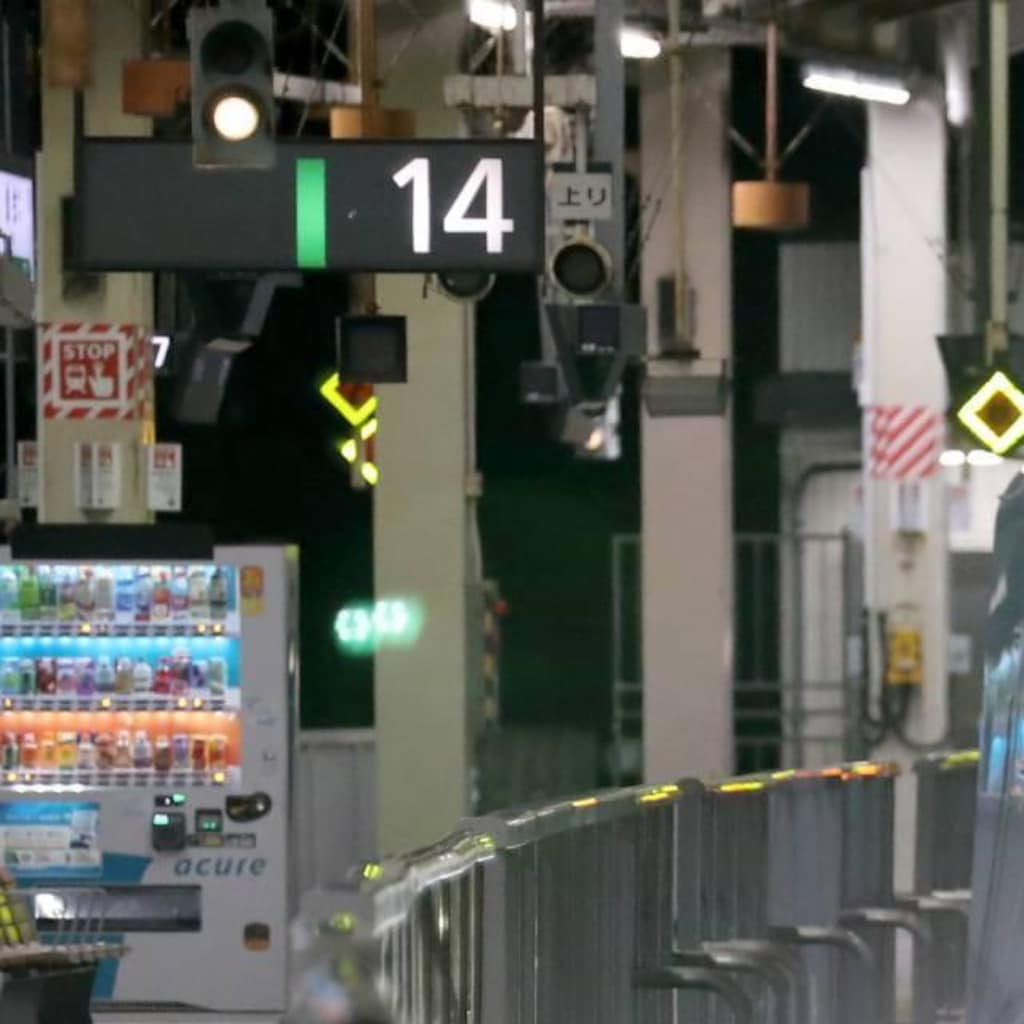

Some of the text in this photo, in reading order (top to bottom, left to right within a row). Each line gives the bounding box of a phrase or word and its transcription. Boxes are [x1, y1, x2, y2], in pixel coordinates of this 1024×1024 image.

[392, 157, 514, 254] 14
[557, 186, 607, 207] 上り
[62, 343, 116, 360] STOP
[174, 857, 267, 877] acure
